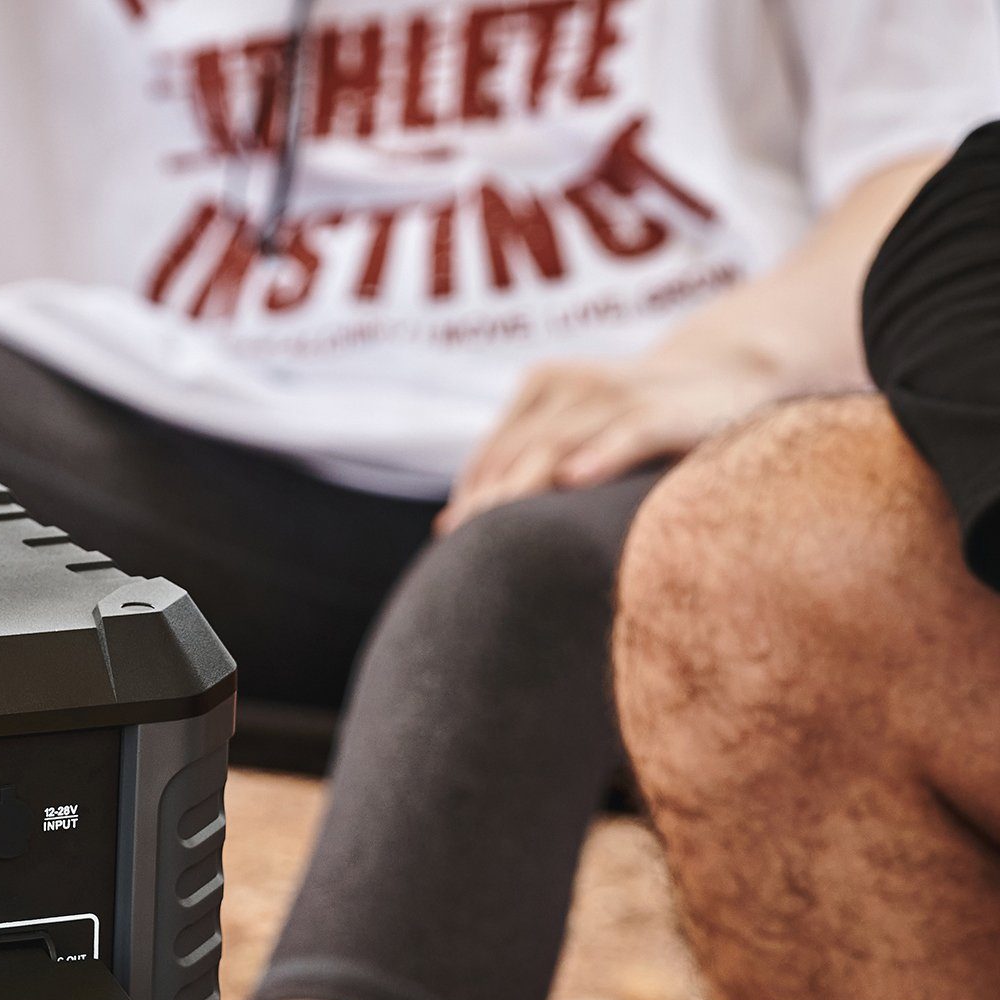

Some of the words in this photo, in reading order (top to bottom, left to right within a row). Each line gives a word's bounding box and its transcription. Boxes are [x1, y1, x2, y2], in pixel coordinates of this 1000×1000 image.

[148, 112, 717, 318] INSTINCT
[44, 804, 79, 818] 12-28V
[43, 818, 79, 832] INPUT
